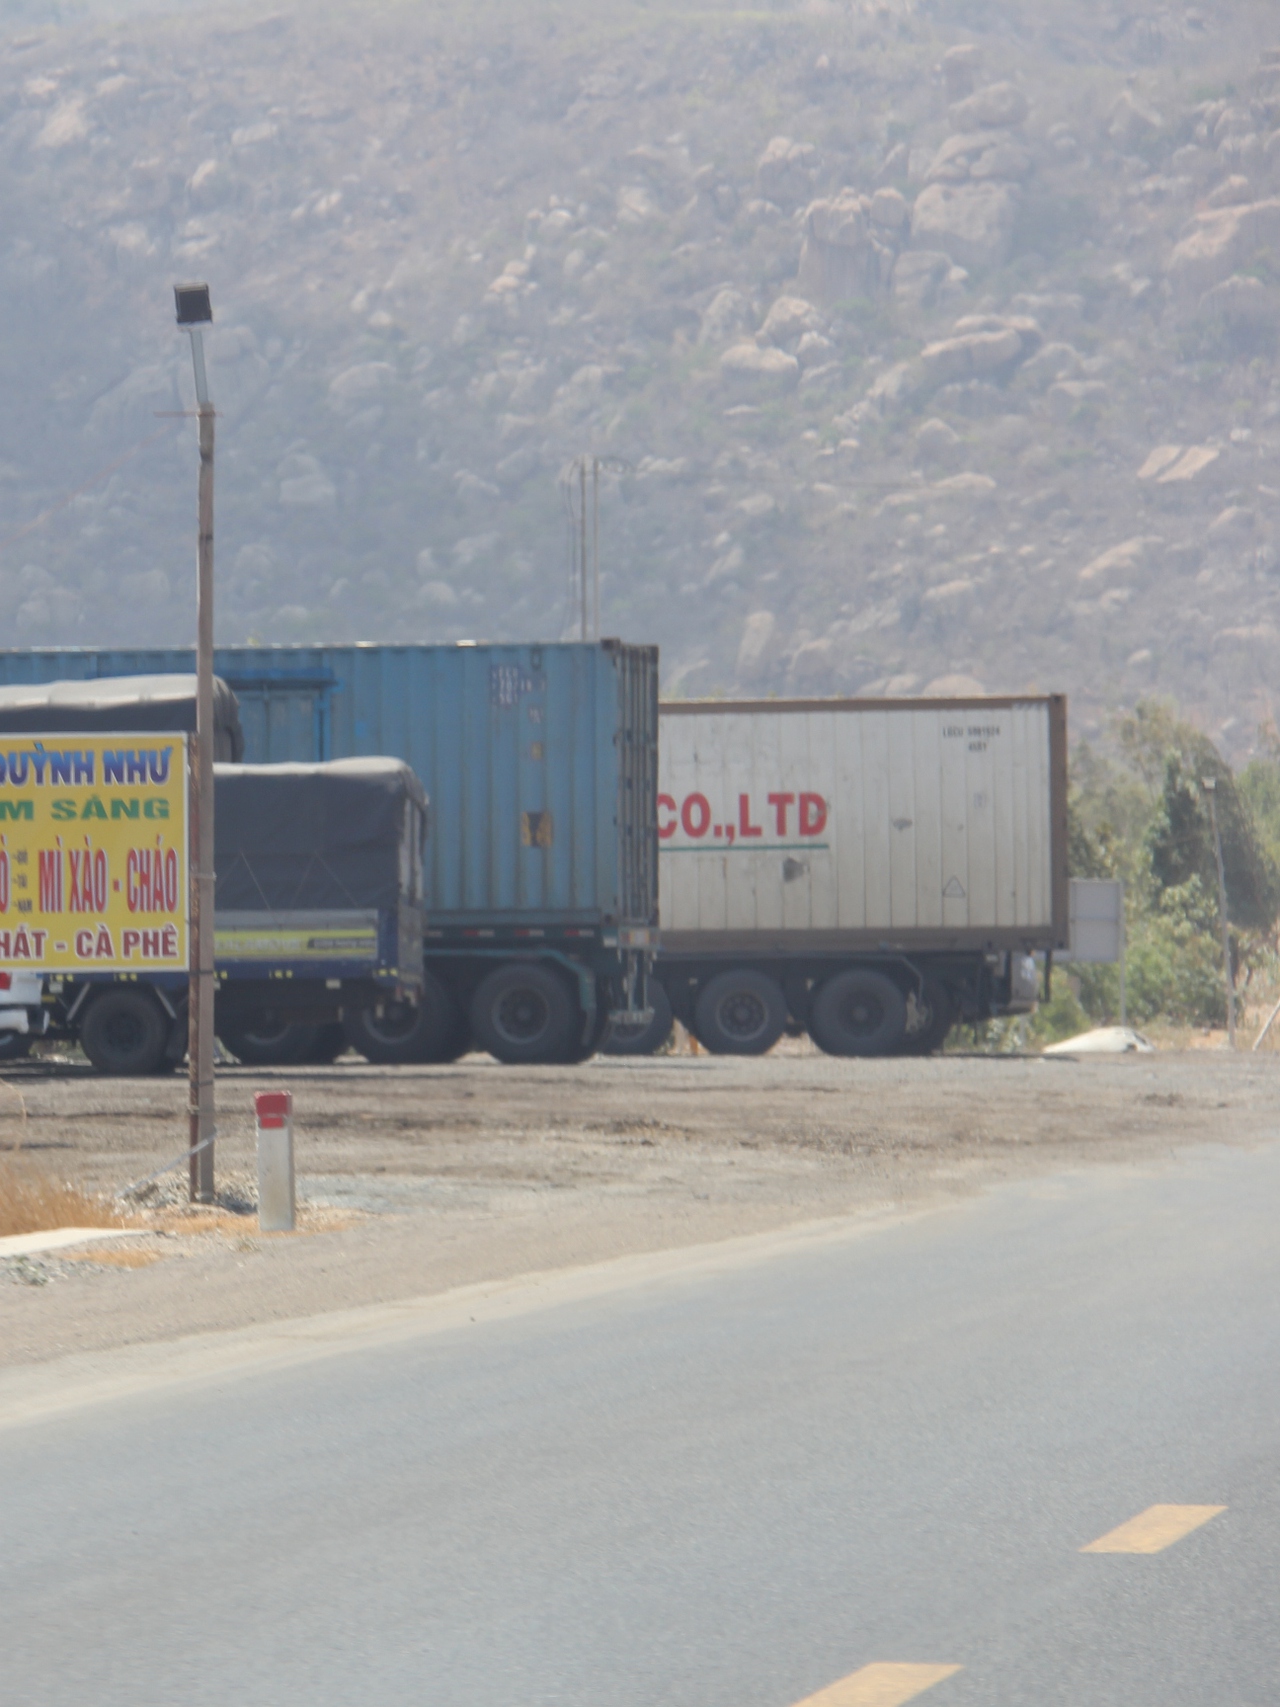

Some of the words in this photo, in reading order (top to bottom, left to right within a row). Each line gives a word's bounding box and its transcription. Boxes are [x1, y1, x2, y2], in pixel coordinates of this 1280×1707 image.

[102, 745, 174, 786] NHƯ
[51, 793, 170, 821] SÁNG
[38, 835, 63, 914] MÌ
[69, 835, 109, 914] XÀO
[127, 834, 179, 914] CHÁO
[75, 923, 115, 959] CÀ
[123, 923, 178, 959] PHÊ
